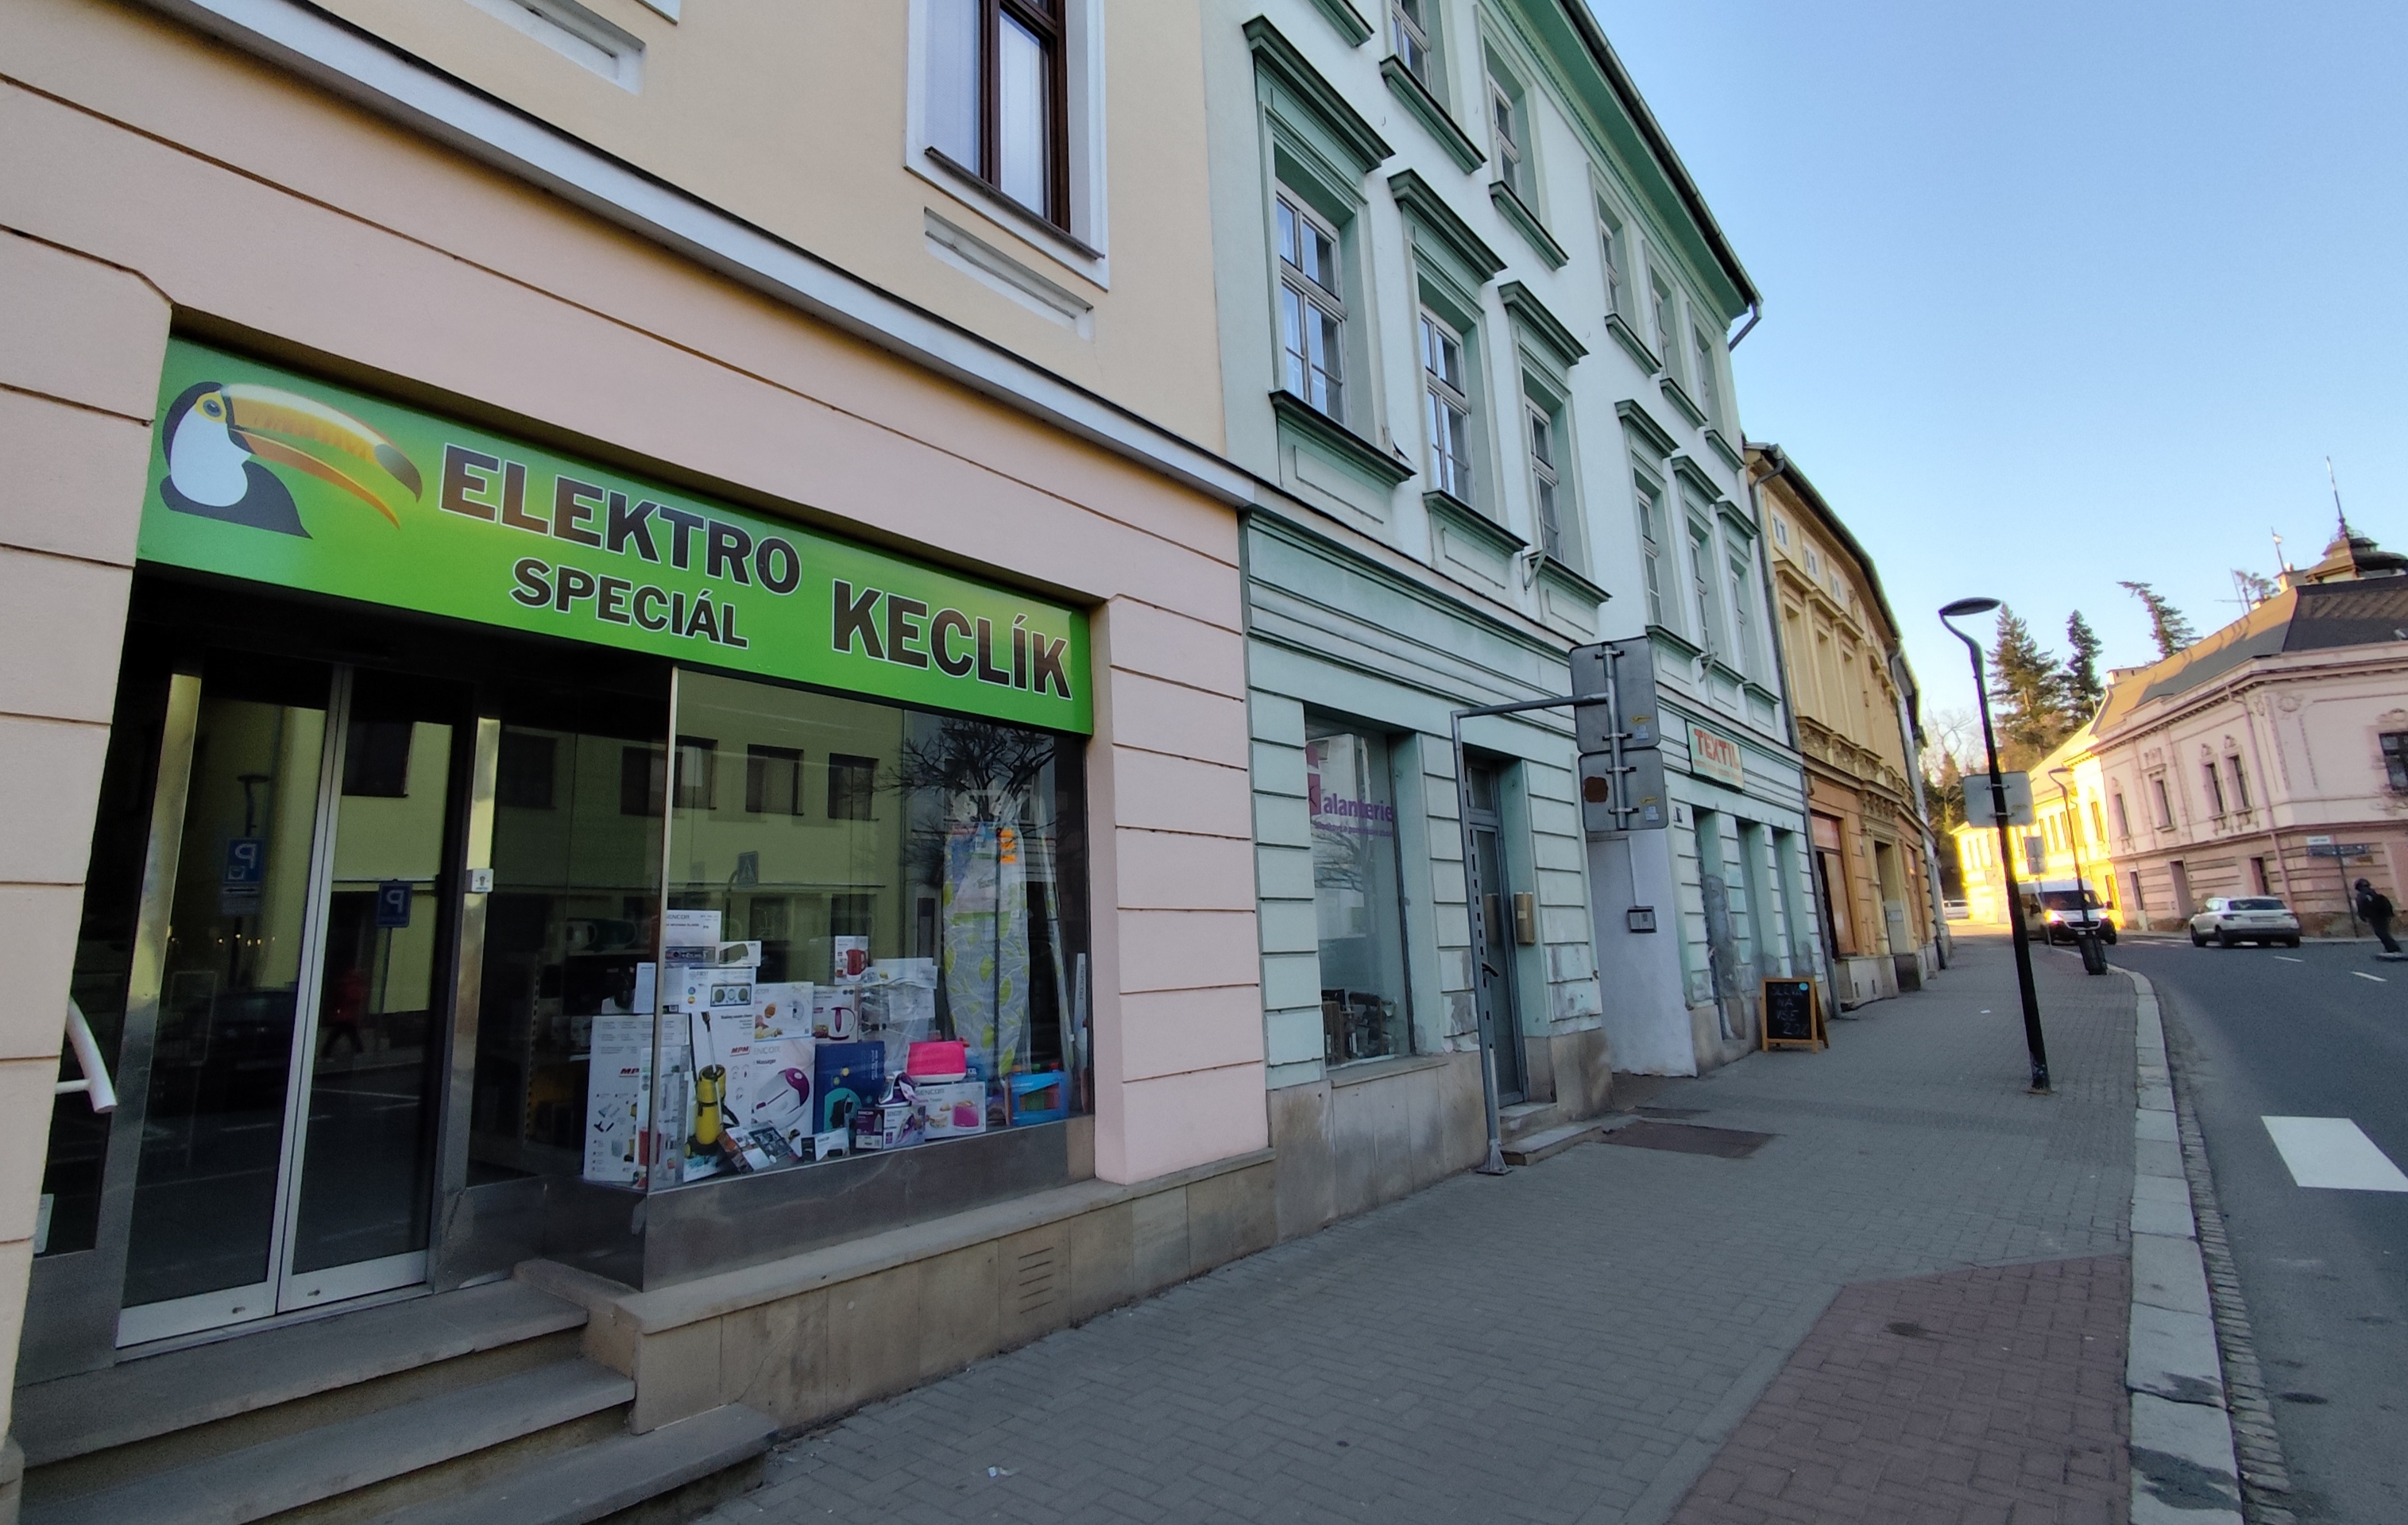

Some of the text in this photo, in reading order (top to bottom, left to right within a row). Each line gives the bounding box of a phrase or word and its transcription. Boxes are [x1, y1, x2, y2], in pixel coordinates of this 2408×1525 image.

[437, 442, 1073, 701] ELEKTRO KECLÍK
[509, 558, 750, 650] SPECIÁL
[1694, 728, 1740, 770] TEXTIL
[753, 1046, 781, 1055] ENCOR
